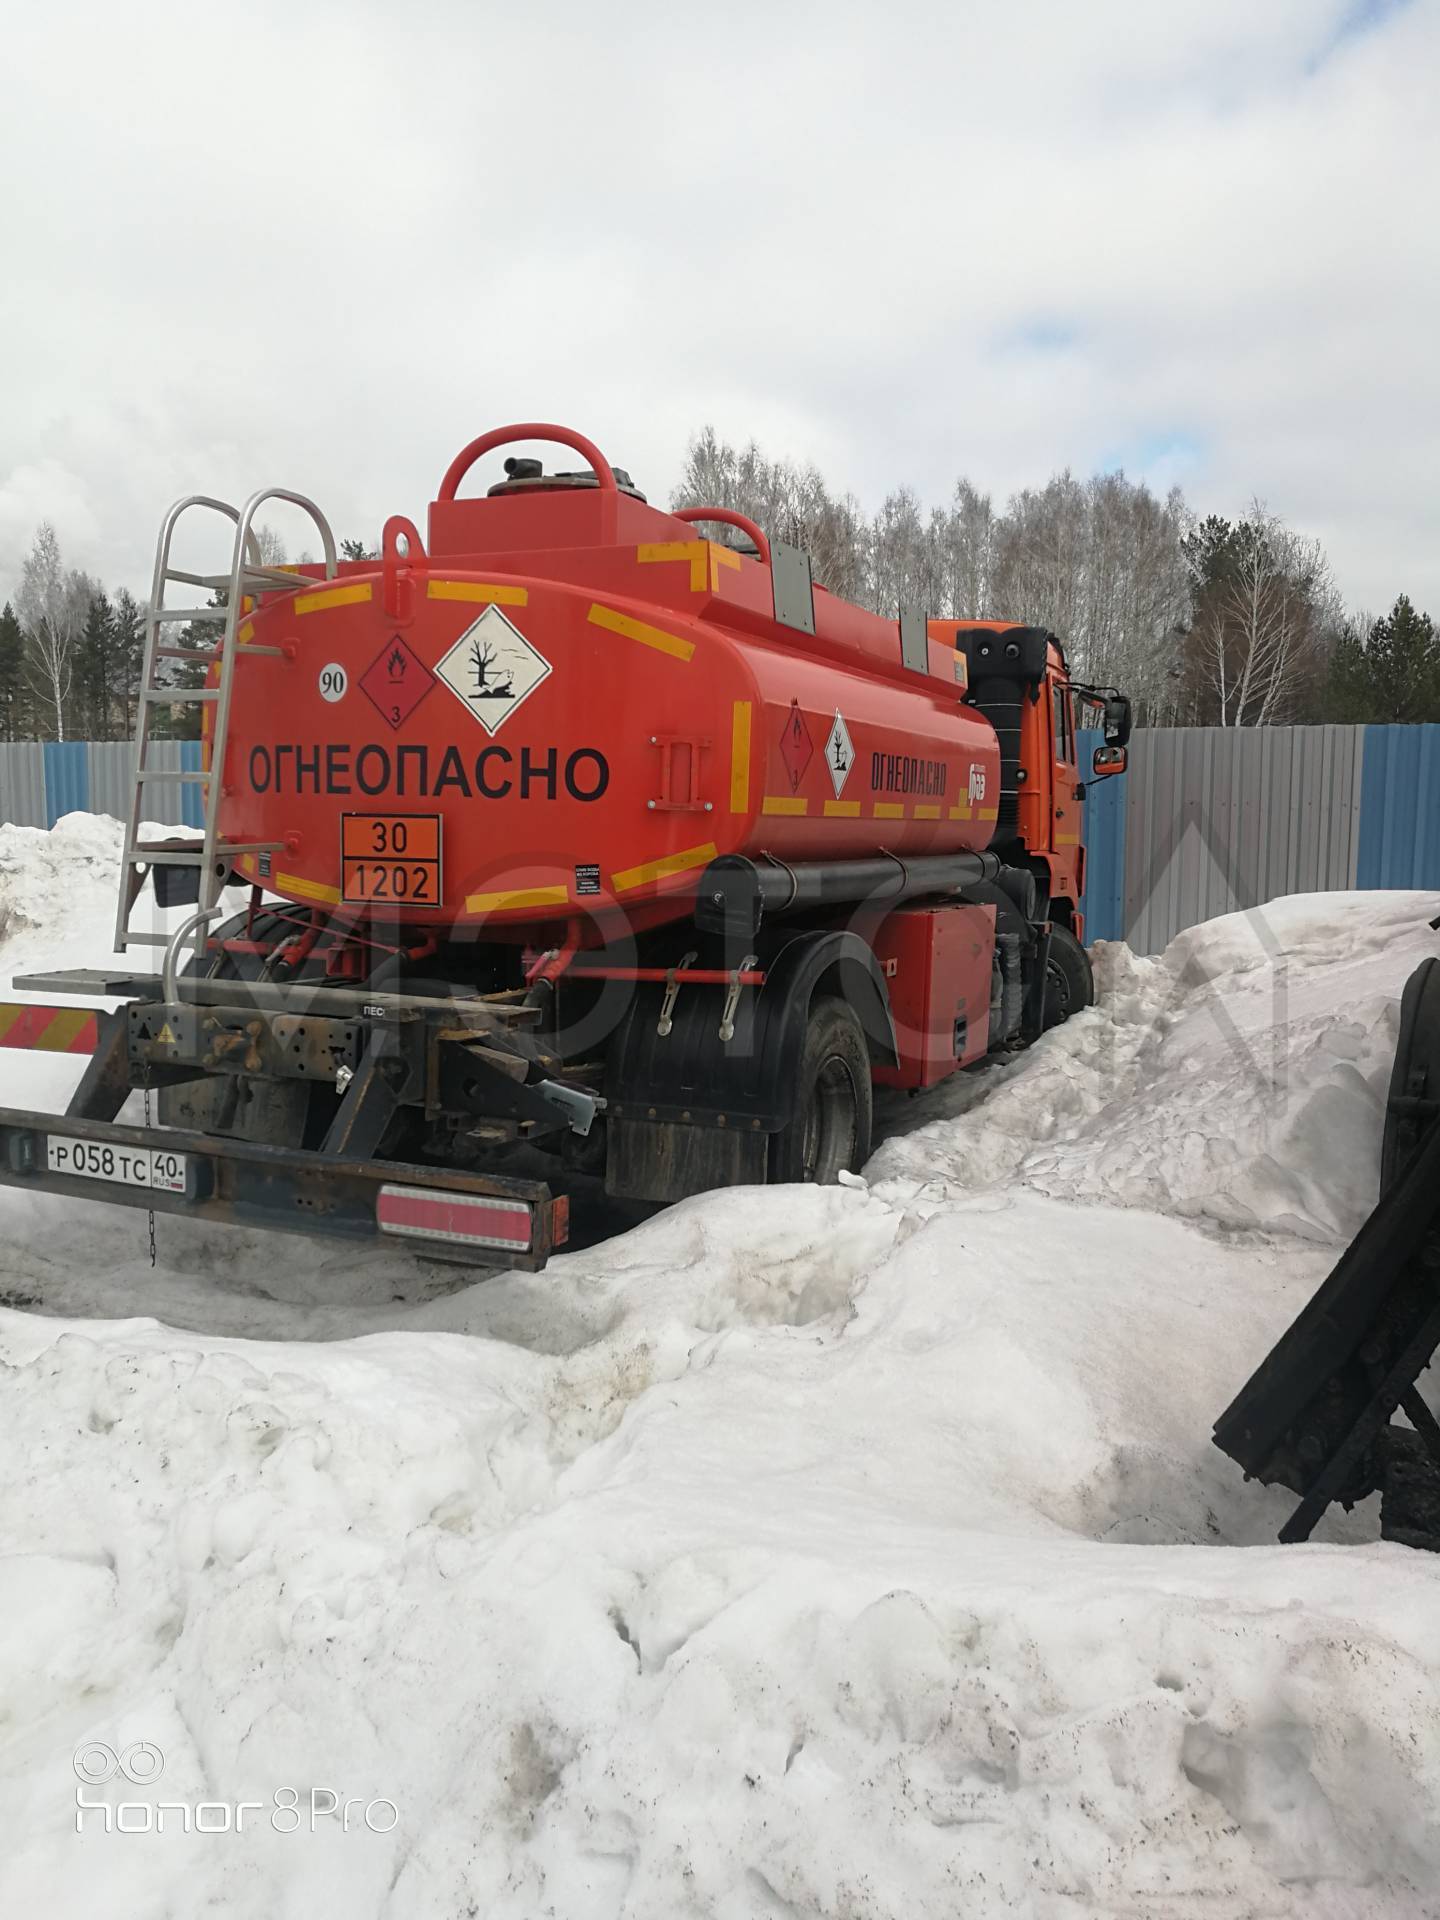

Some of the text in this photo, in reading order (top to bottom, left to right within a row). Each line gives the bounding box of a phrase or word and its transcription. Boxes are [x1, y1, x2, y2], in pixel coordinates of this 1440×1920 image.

[322, 671, 344, 693] 90
[391, 706, 401, 723] 3
[248, 745, 610, 801] ОГНЕОПАСНО
[871, 752, 947, 796] ОГНЕОПАСНО
[371, 821, 407, 853] 30
[356, 865, 429, 899] 1202
[154, 1154, 177, 1178] 40
[153, 1178, 170, 1187] RUS
